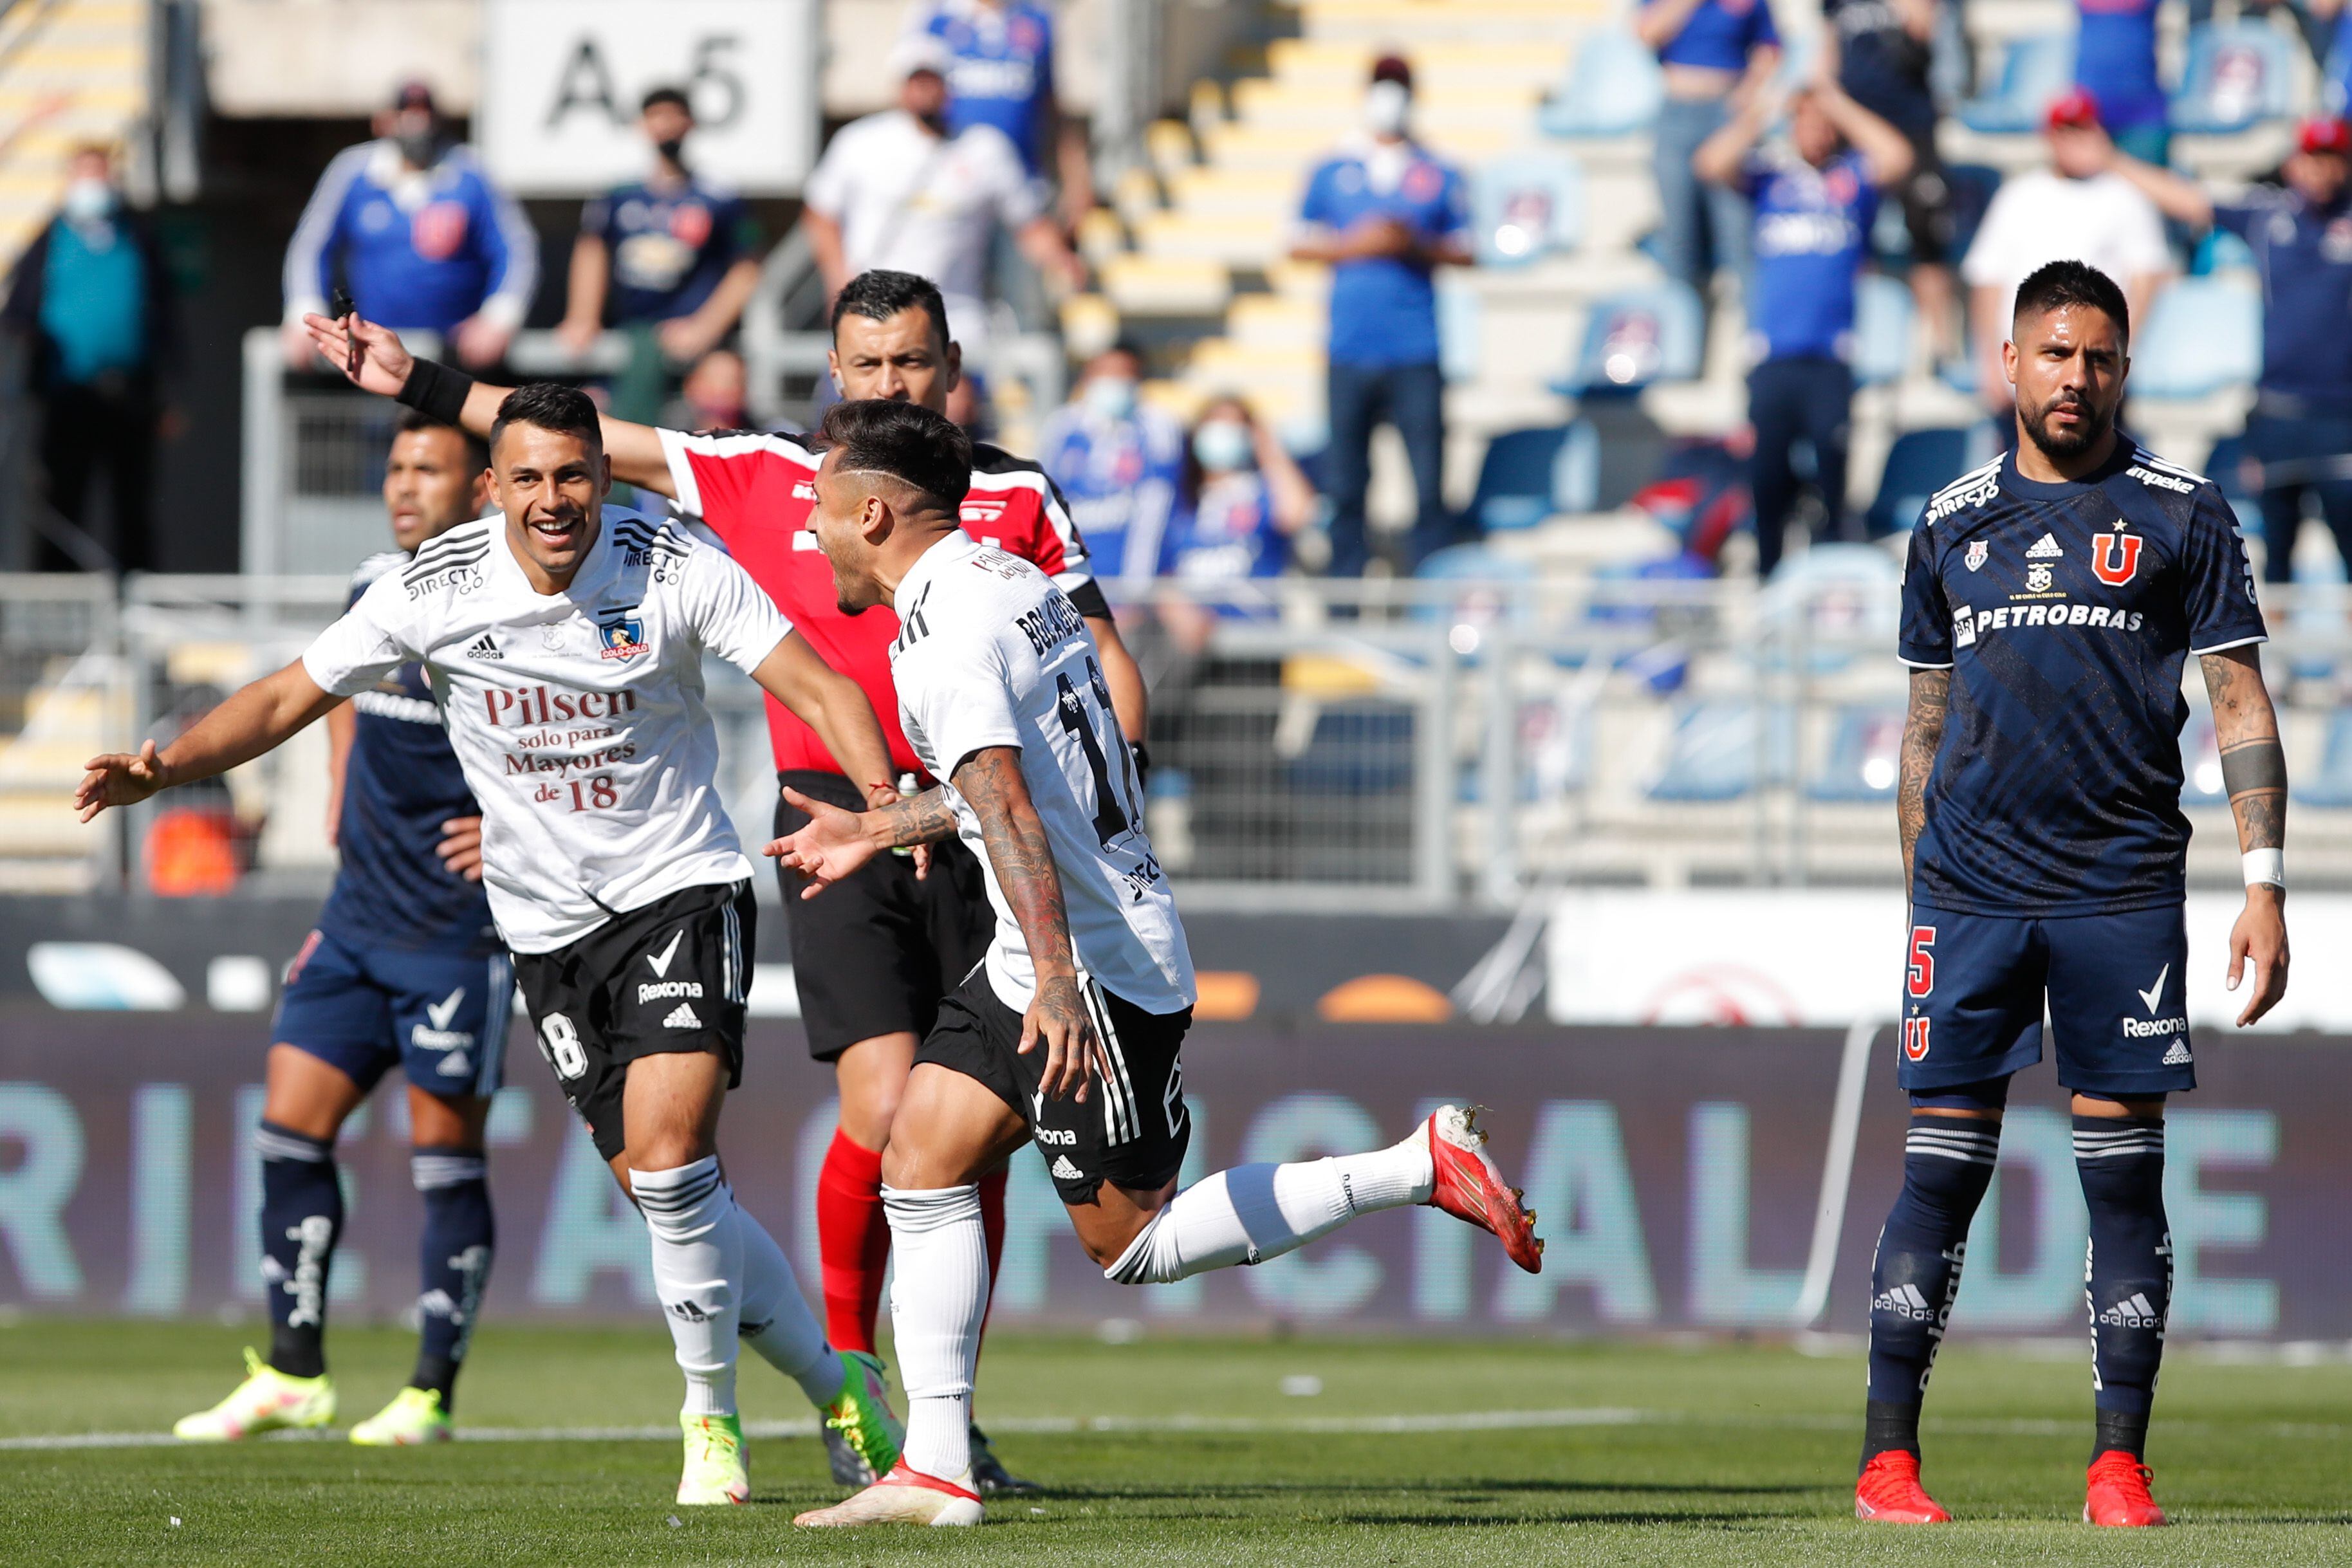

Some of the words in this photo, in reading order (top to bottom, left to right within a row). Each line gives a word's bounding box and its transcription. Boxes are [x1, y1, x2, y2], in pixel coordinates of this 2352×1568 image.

[545, 32, 629, 133] A
[2125, 465, 2196, 495] impeke
[2025, 548, 2064, 558] adidas
[2091, 533, 2144, 587] U
[404, 561, 481, 602] DIRECTV
[459, 575, 485, 596] GO
[654, 569, 680, 586] GO
[1958, 620, 1972, 636] BR
[1977, 604, 2144, 632] PETROBRAS
[467, 648, 505, 659] adidas
[602, 643, 649, 658] COLO-COLO
[481, 685, 636, 728] Pilsen
[518, 728, 562, 750] solo
[568, 726, 615, 749] para
[503, 741, 636, 779] Mayores
[534, 782, 561, 803] de
[566, 775, 620, 813] 18
[1907, 926, 1936, 998] 5
[638, 981, 703, 1005] Rexona
[662, 1017, 703, 1029] adidas
[2123, 1017, 2187, 1038] Rexona
[1905, 1016, 1931, 1062] U
[1940, 1104, 2282, 1336] DE
[1874, 1297, 1936, 1322] adidas
[2099, 1313, 2163, 1329] adidas
